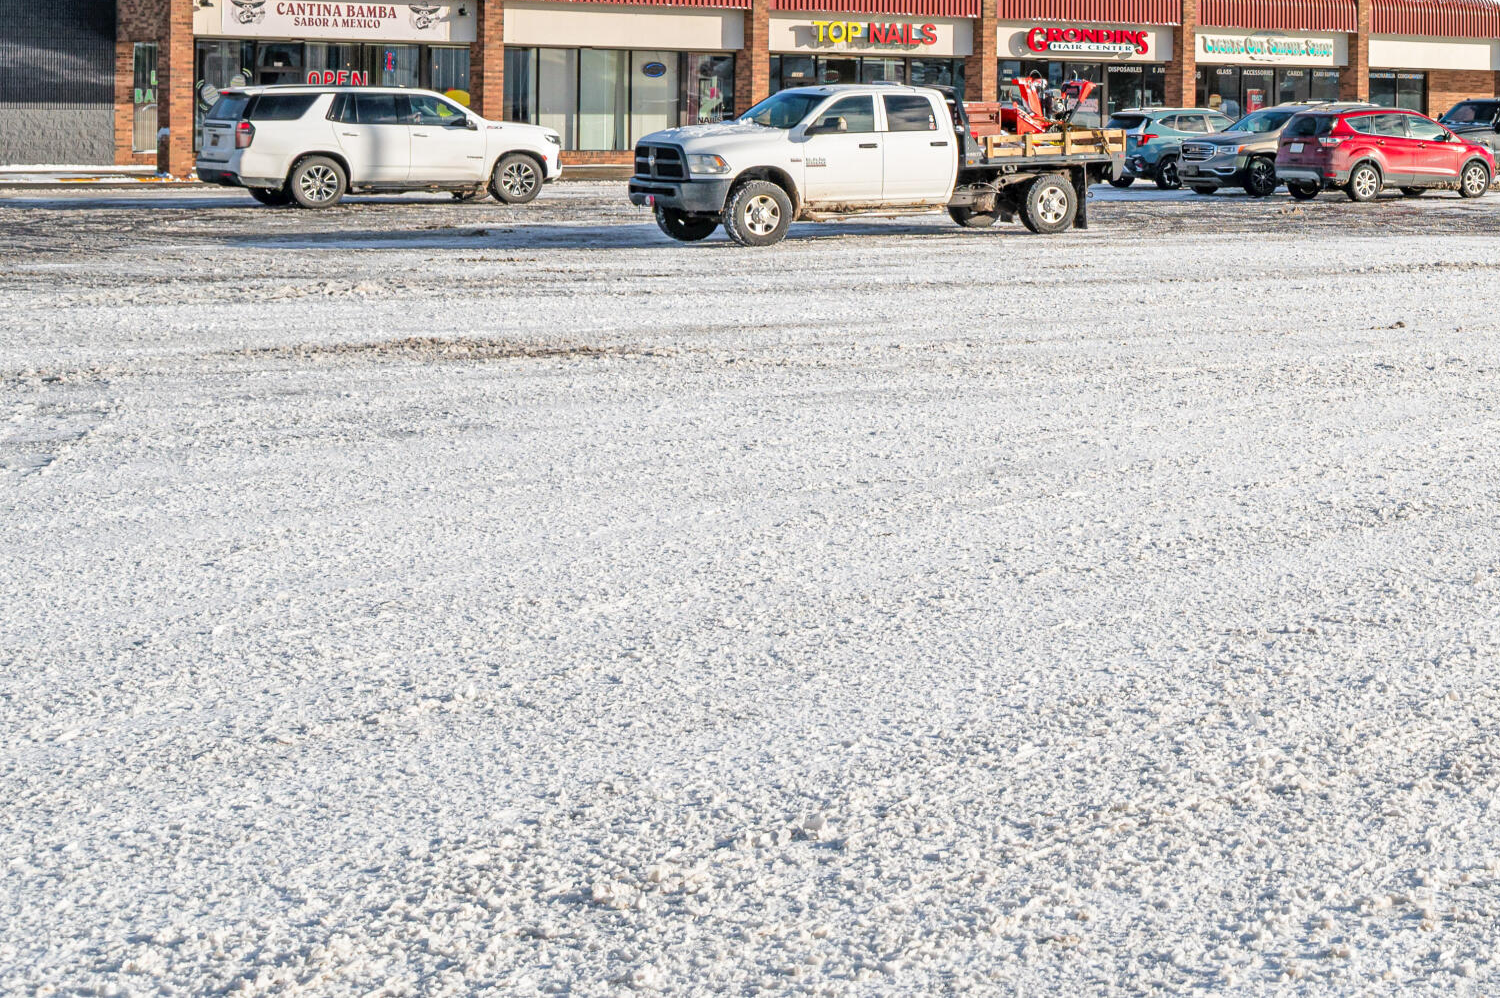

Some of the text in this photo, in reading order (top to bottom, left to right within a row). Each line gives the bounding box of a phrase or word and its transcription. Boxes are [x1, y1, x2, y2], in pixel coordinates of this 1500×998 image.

[276, 2, 397, 19] CANTINA BAMBA
[294, 17, 381, 29] SABOR A MEXICO
[812, 20, 937, 45] TOP NAILS
[1027, 27, 1148, 55] GRONDINS
[1088, 44, 1132, 52] CENTER
[307, 69, 368, 86] OPEN
